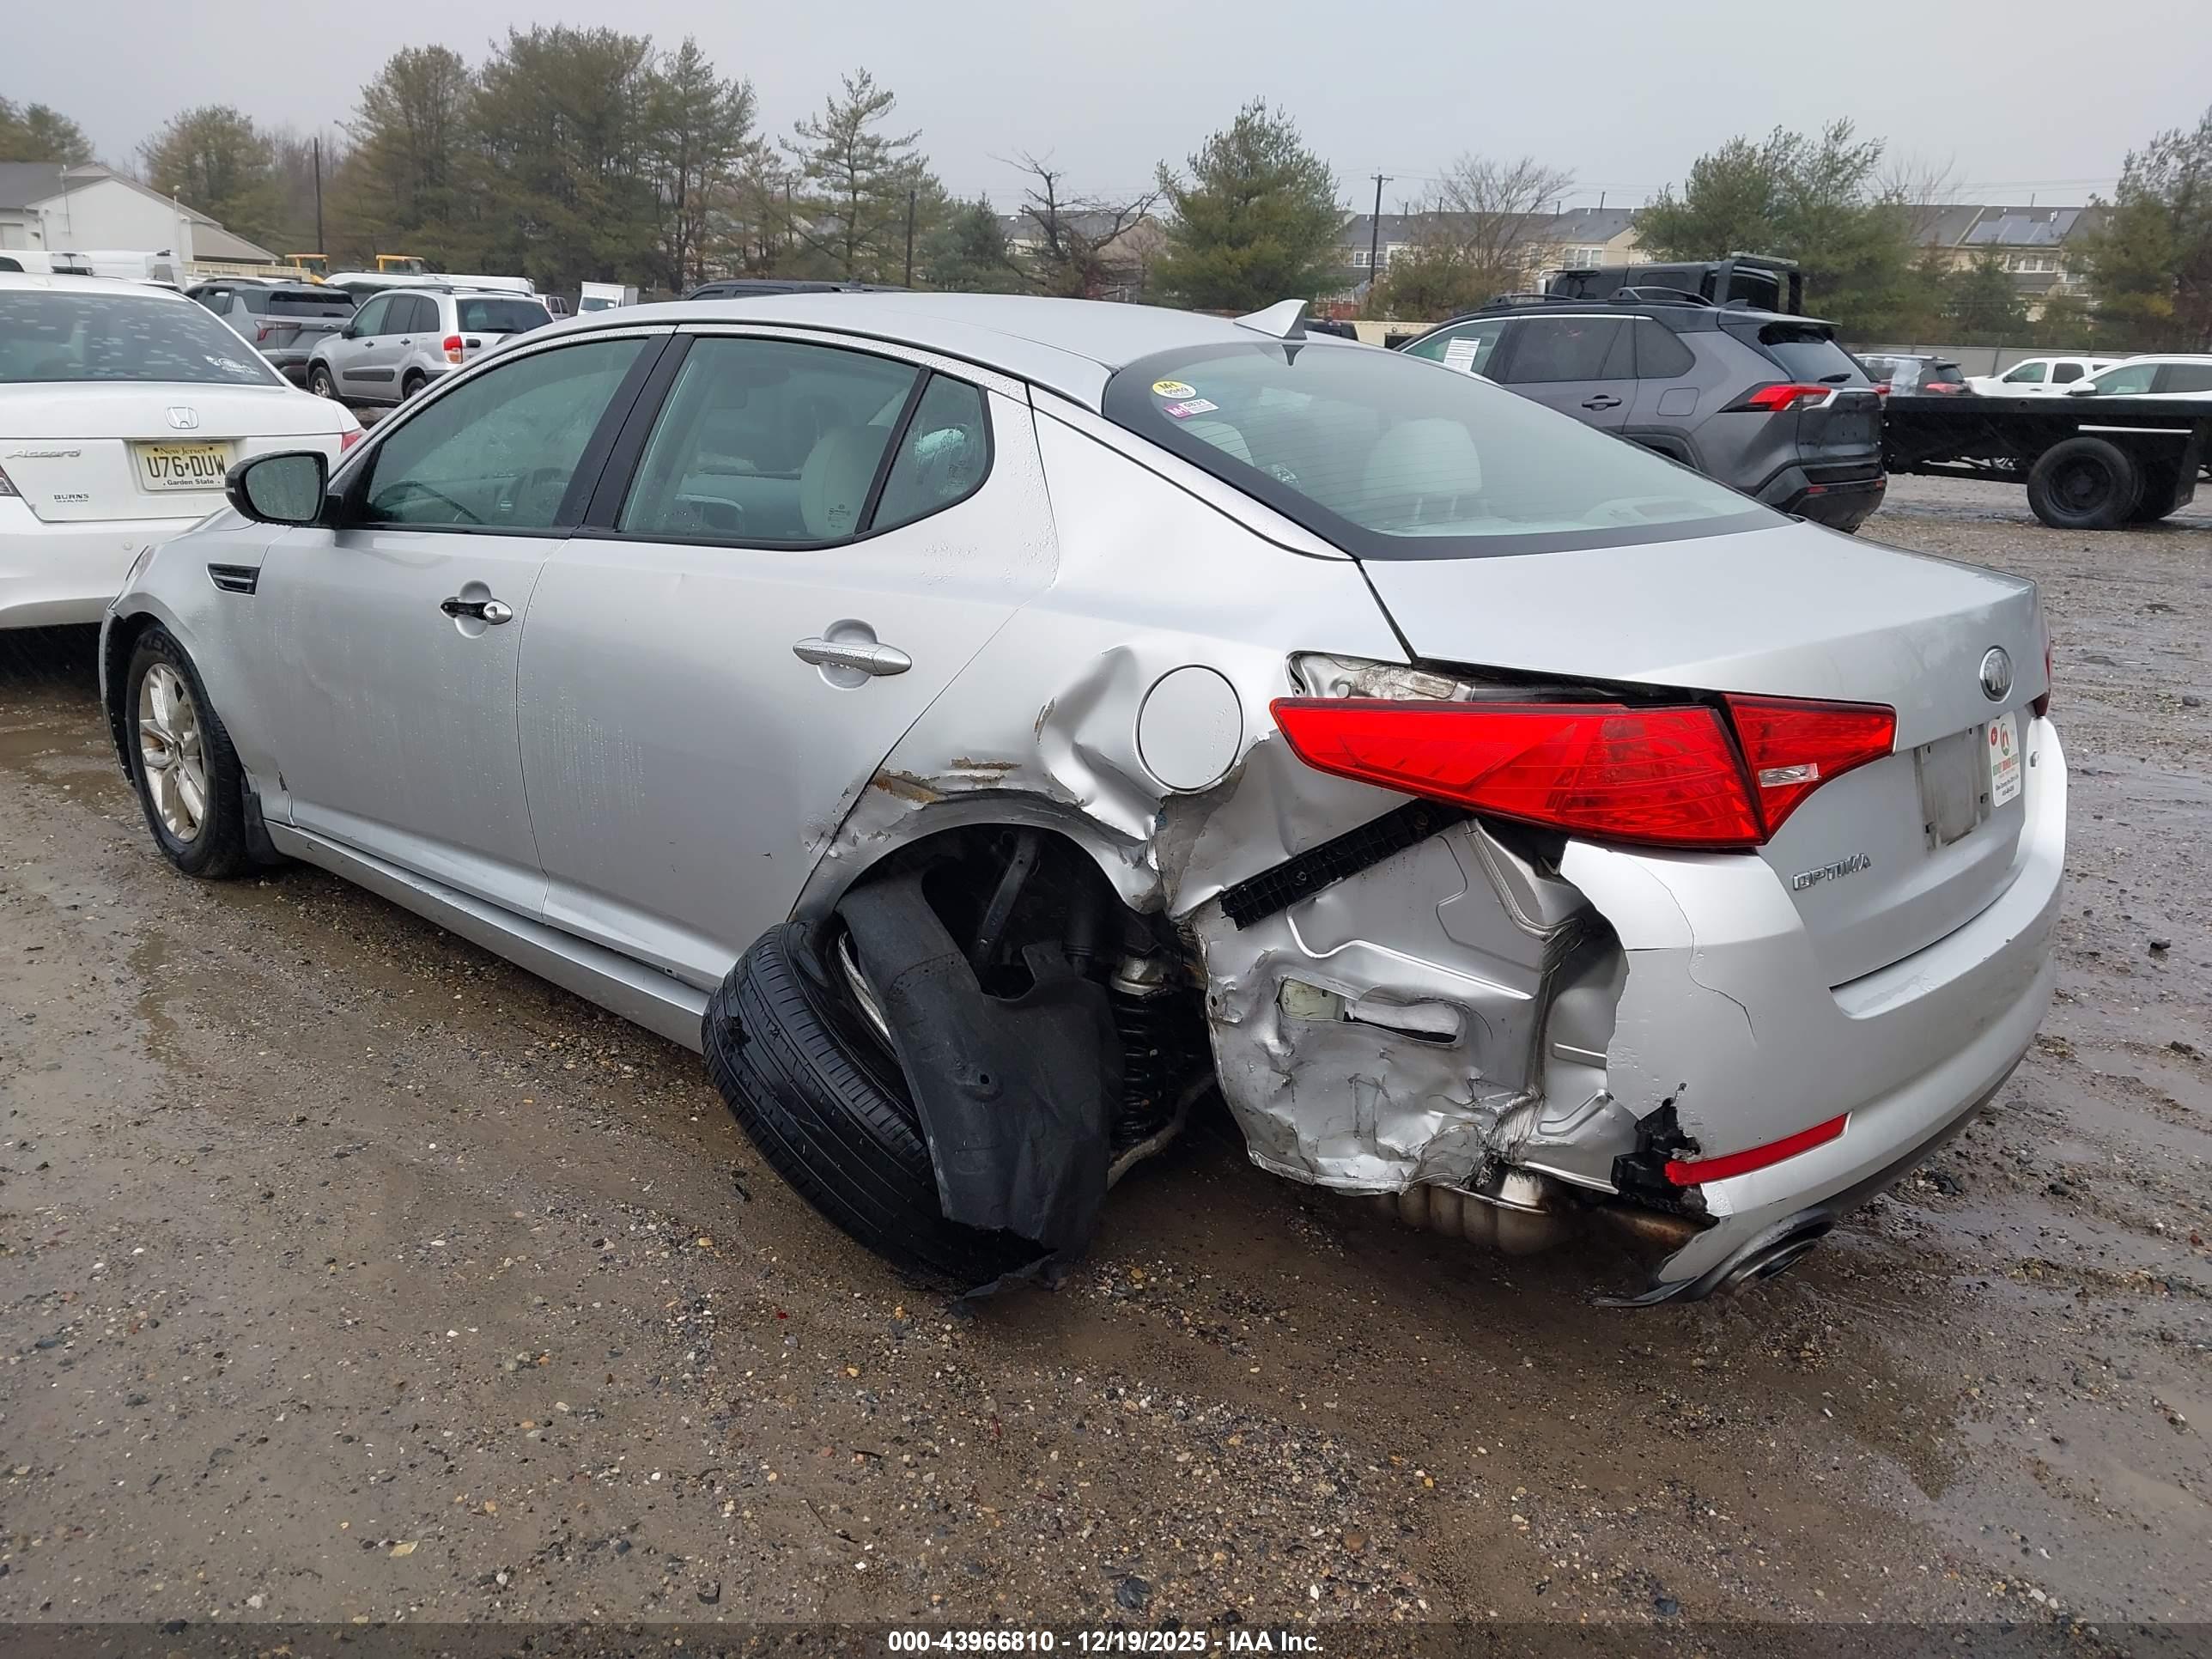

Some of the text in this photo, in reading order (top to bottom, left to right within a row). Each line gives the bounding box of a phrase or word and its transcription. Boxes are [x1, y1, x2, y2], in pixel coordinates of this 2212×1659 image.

[5, 449, 82, 459] Accord
[182, 447, 207, 456] Jersey
[1793, 853, 1872, 891] OPTIMA
